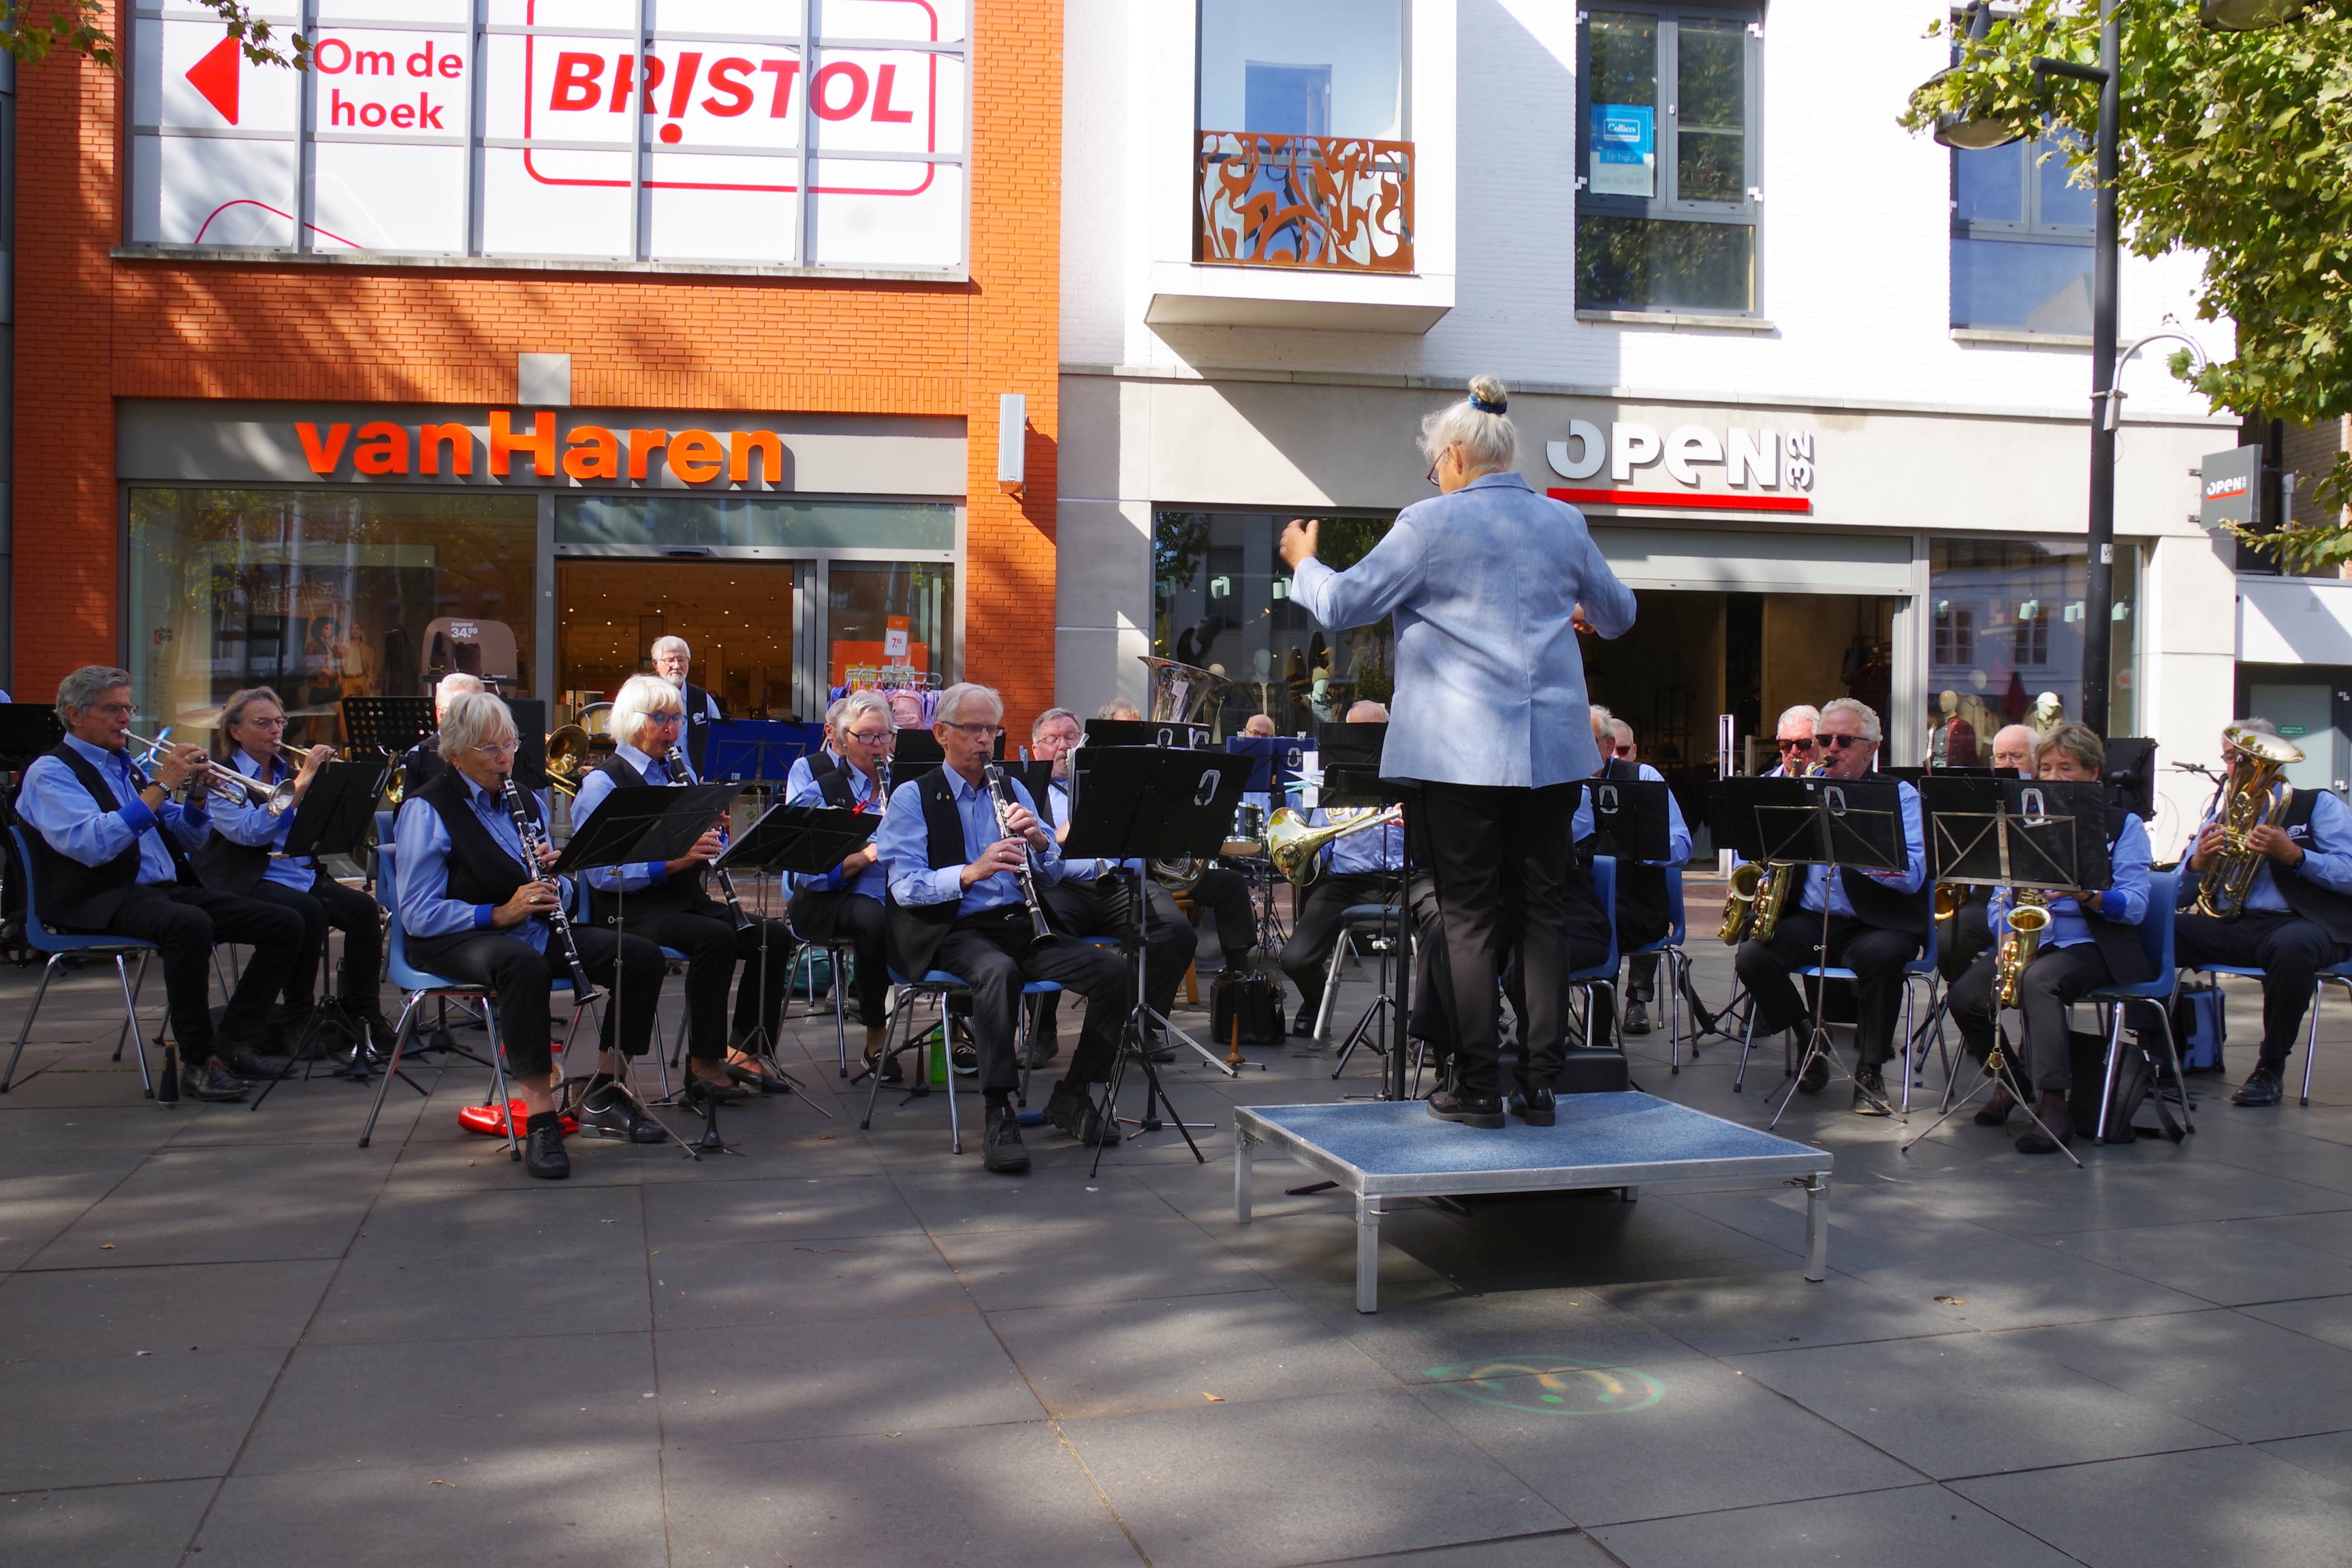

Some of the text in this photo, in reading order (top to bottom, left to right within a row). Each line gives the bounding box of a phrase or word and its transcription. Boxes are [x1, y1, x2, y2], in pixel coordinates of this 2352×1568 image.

[314, 38, 463, 79] Om de
[331, 88, 444, 129] hoek
[1608, 123, 1636, 133] Colliers
